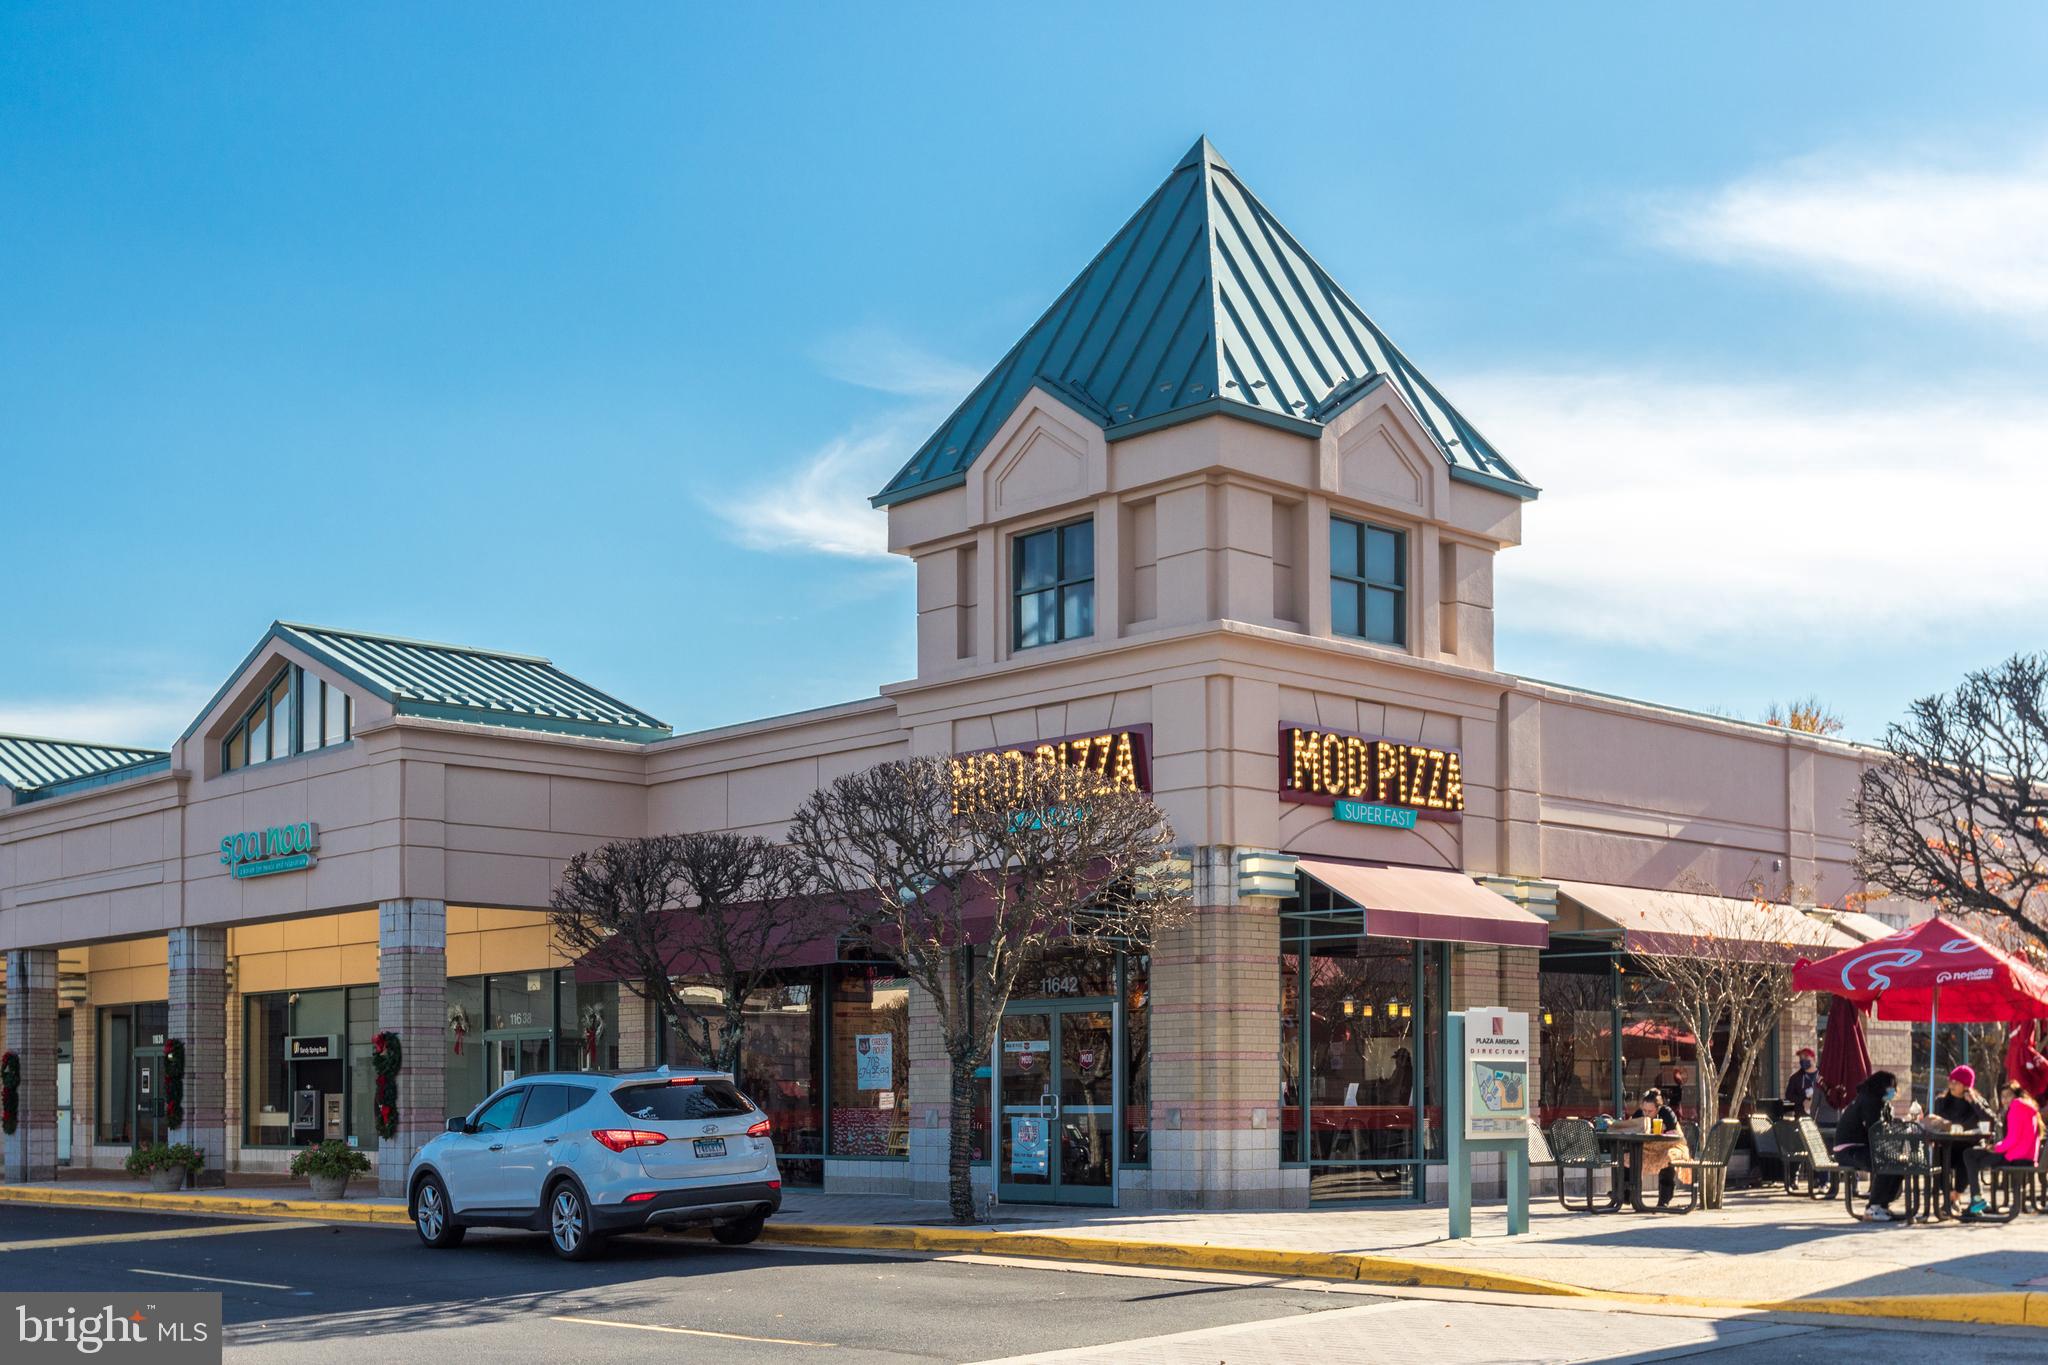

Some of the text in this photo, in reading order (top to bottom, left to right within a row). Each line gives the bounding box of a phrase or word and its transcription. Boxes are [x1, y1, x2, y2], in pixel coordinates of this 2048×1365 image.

[1293, 727, 1464, 811] MOD PIZZA
[1345, 804, 1412, 826] SUPER FAST
[220, 822, 313, 880] spa noa
[1040, 976, 1079, 993] 11642
[1475, 1037, 1520, 1046] PLAZA AMERICA
